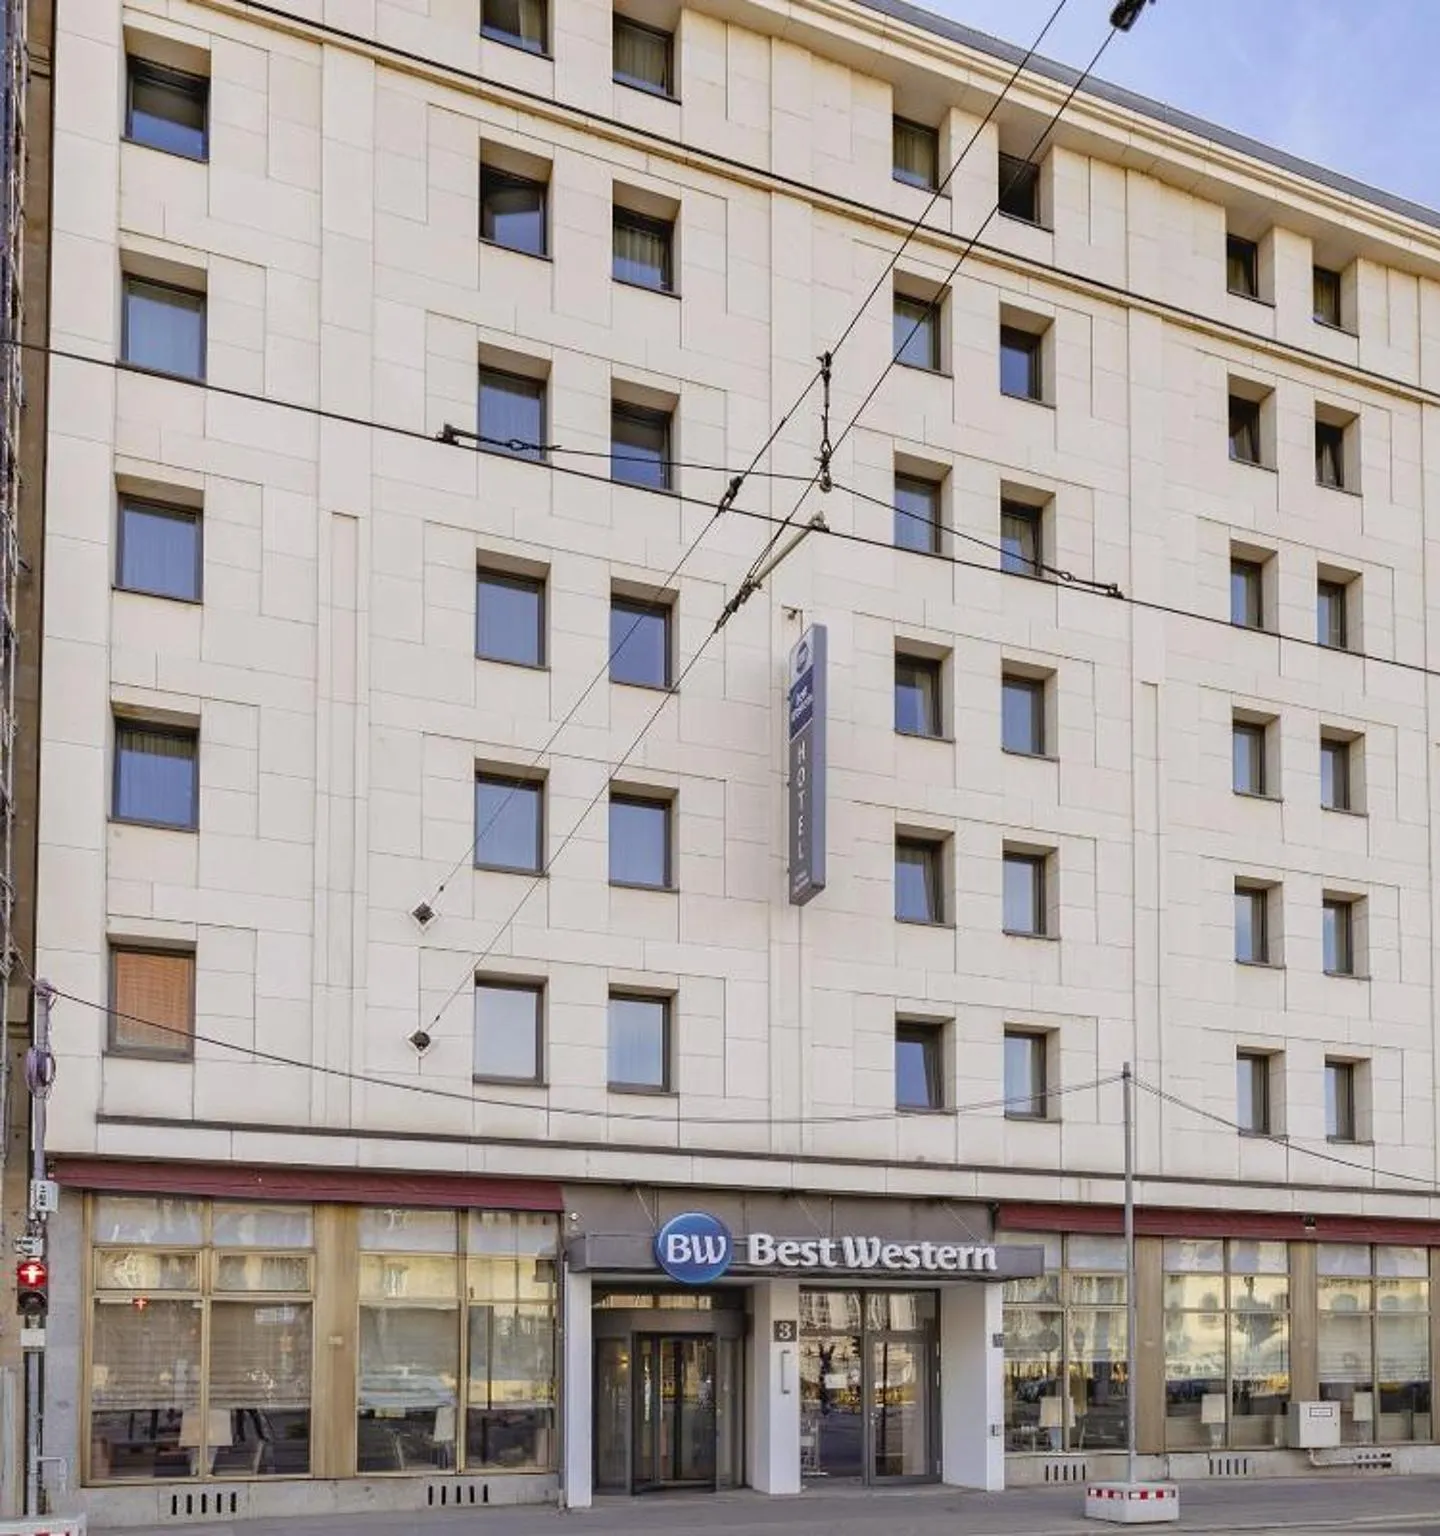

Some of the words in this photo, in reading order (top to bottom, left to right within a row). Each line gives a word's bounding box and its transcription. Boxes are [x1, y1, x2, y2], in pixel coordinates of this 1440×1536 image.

[797, 740, 806, 860] HOTEL
[666, 1233, 727, 1265] BW
[748, 1232, 837, 1268] Best
[842, 1235, 998, 1271] Western
[778, 1322, 792, 1340] 3
